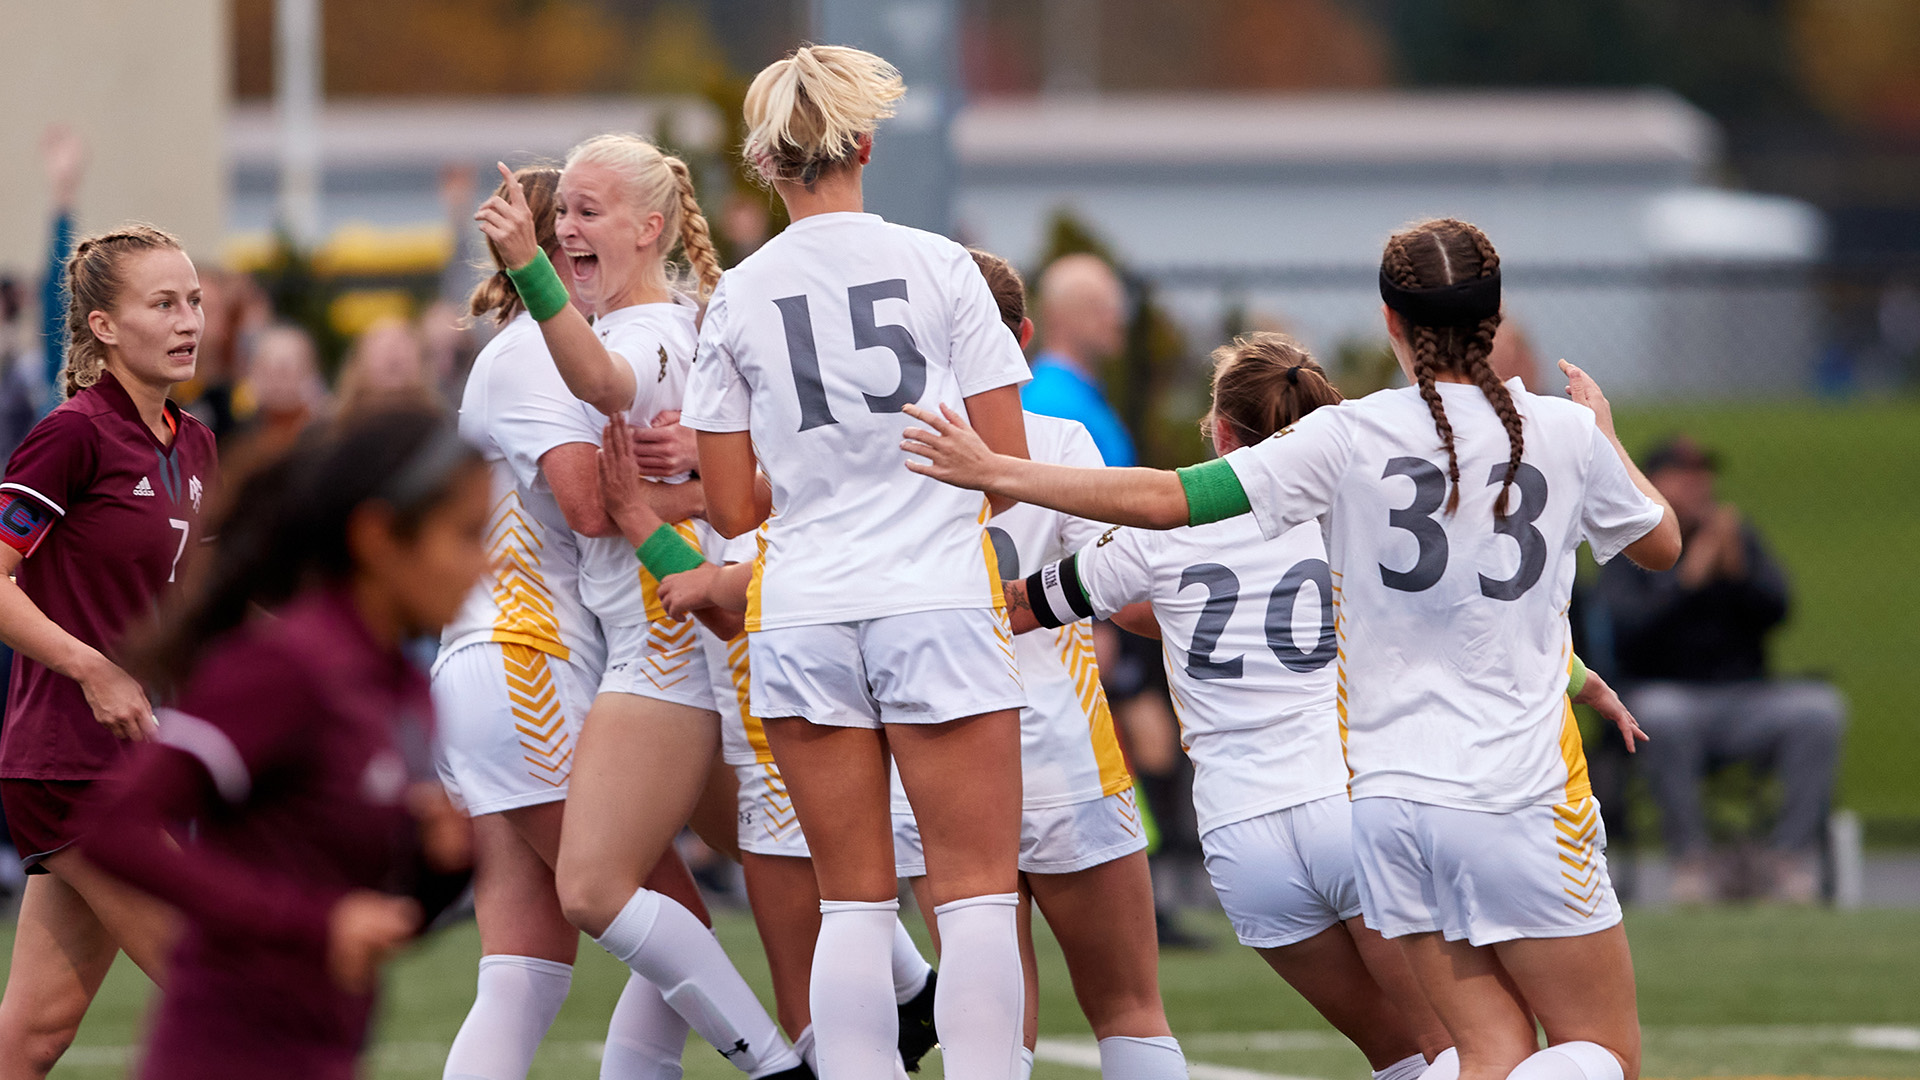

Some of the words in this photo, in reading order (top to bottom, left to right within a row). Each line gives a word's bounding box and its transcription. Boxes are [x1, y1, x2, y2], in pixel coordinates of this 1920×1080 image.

[771, 278, 927, 432] 15
[2, 498, 40, 536] C
[132, 489, 155, 497] adidas
[1378, 456, 1548, 601] 33
[168, 518, 190, 583] 7
[1177, 558, 1338, 680] 20
